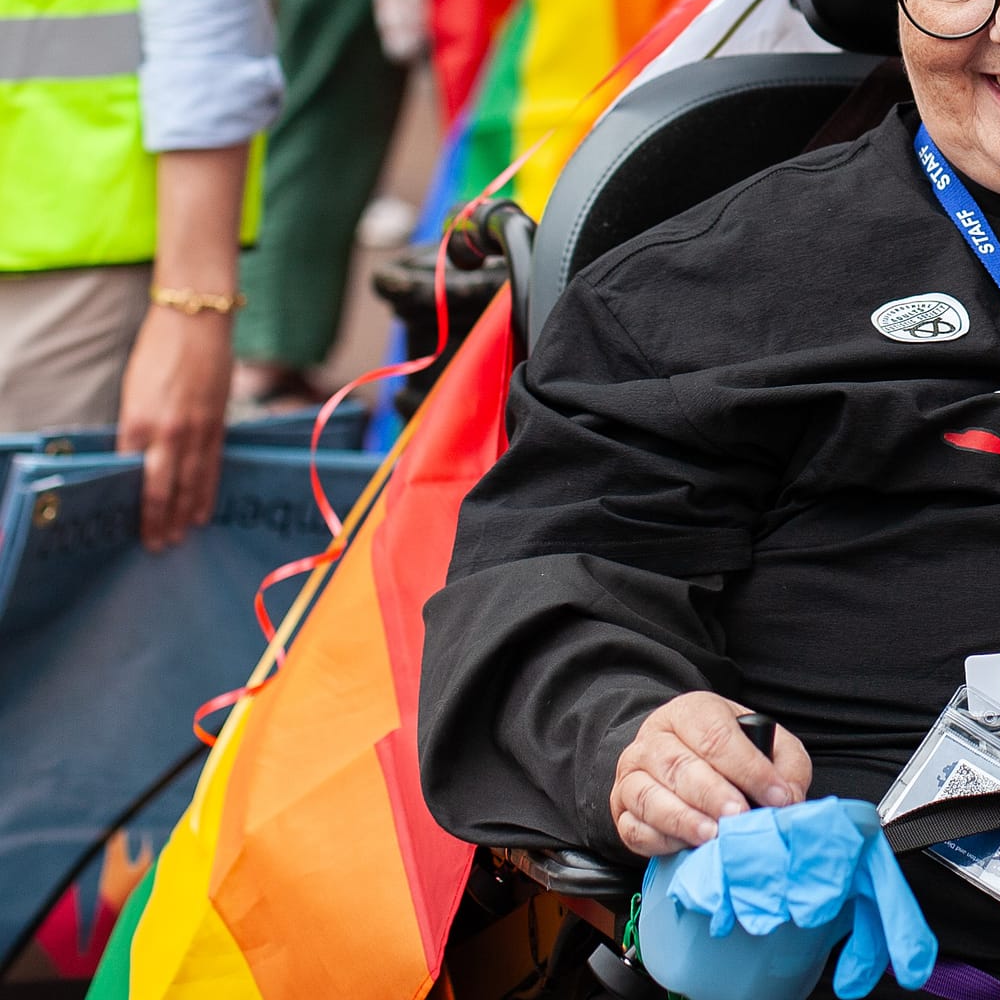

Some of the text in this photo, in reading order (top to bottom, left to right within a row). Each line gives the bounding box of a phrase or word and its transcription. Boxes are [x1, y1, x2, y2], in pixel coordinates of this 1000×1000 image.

[918, 145, 951, 191] STAFF
[956, 209, 995, 254] STAFF
[916, 304, 947, 320] SOCIETY
